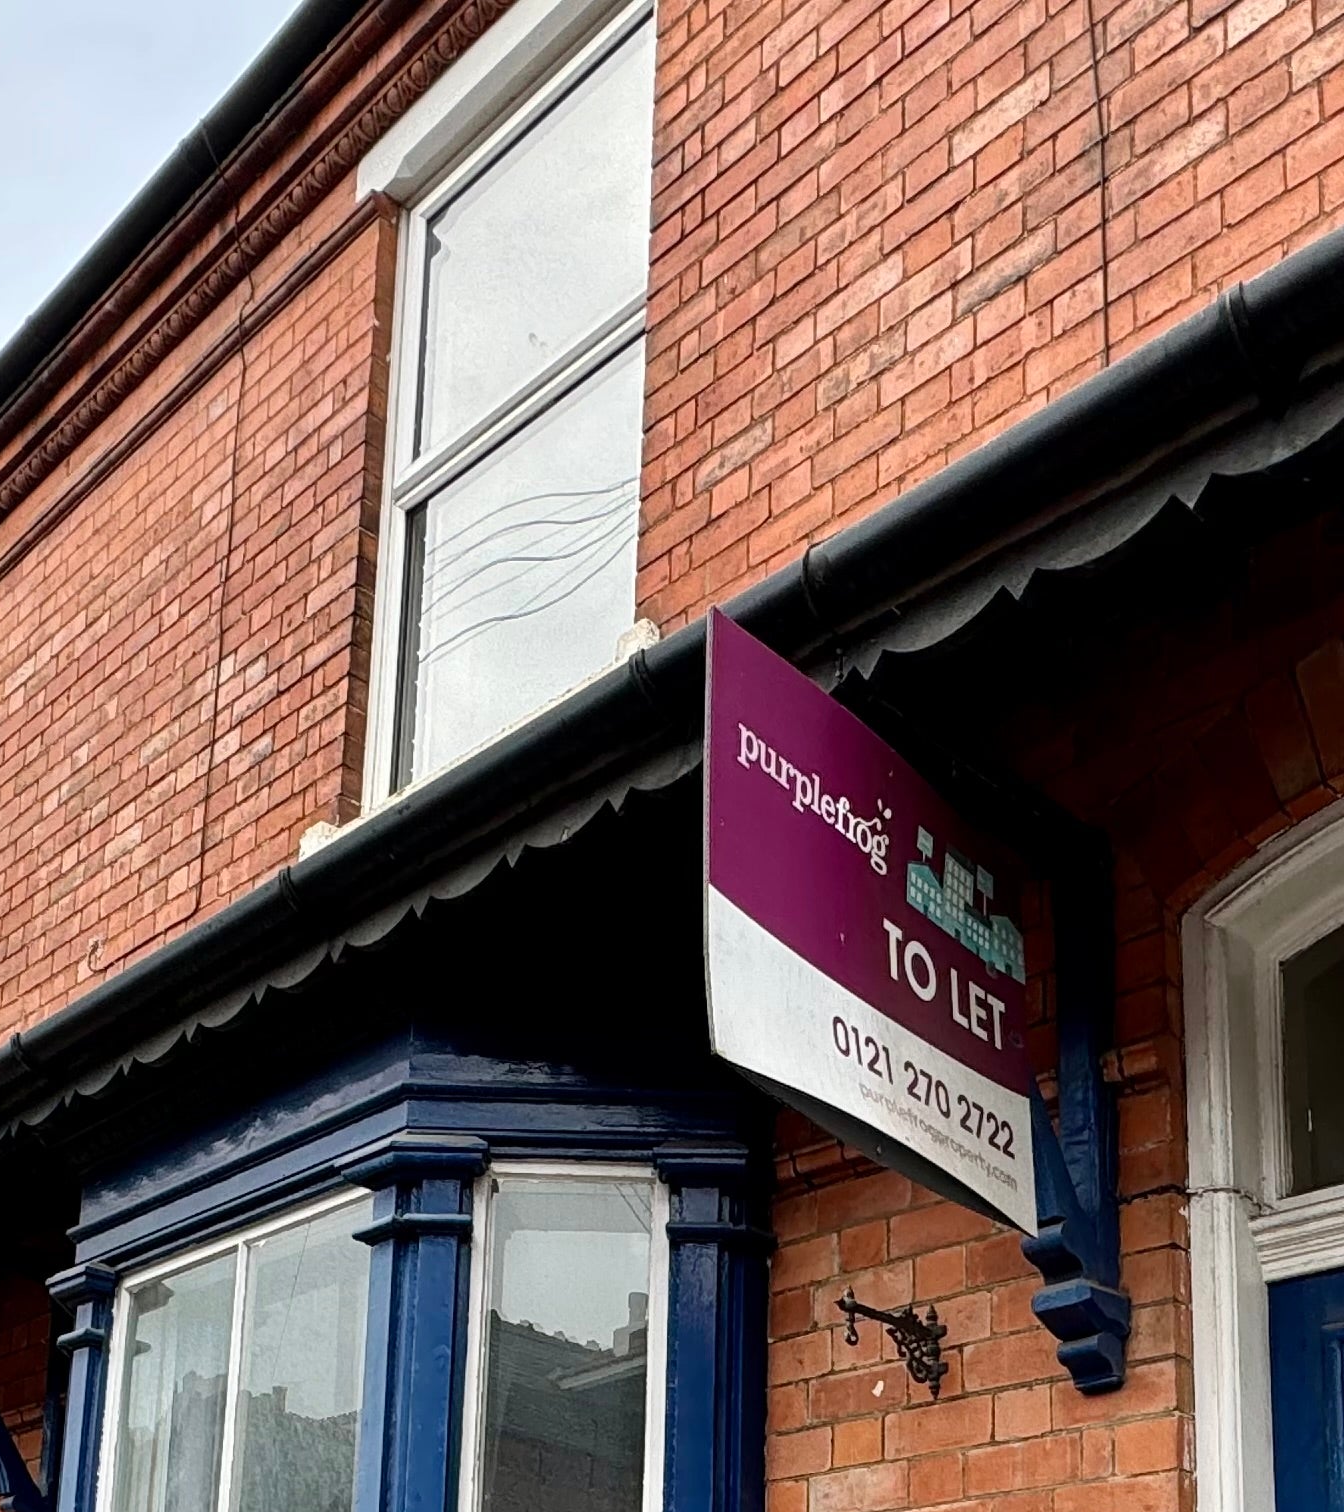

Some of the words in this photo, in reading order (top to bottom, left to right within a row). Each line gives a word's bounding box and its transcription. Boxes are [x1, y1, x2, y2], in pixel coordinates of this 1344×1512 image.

[737, 722, 890, 876] purplefrog
[883, 917, 937, 1002] TO
[950, 967, 1006, 1051] LET
[832, 1015, 894, 1086] 0121
[903, 1060, 951, 1120] 270
[957, 1094, 1016, 1161] 2722
[858, 1081, 1018, 1193] purplefrogproperty.com
